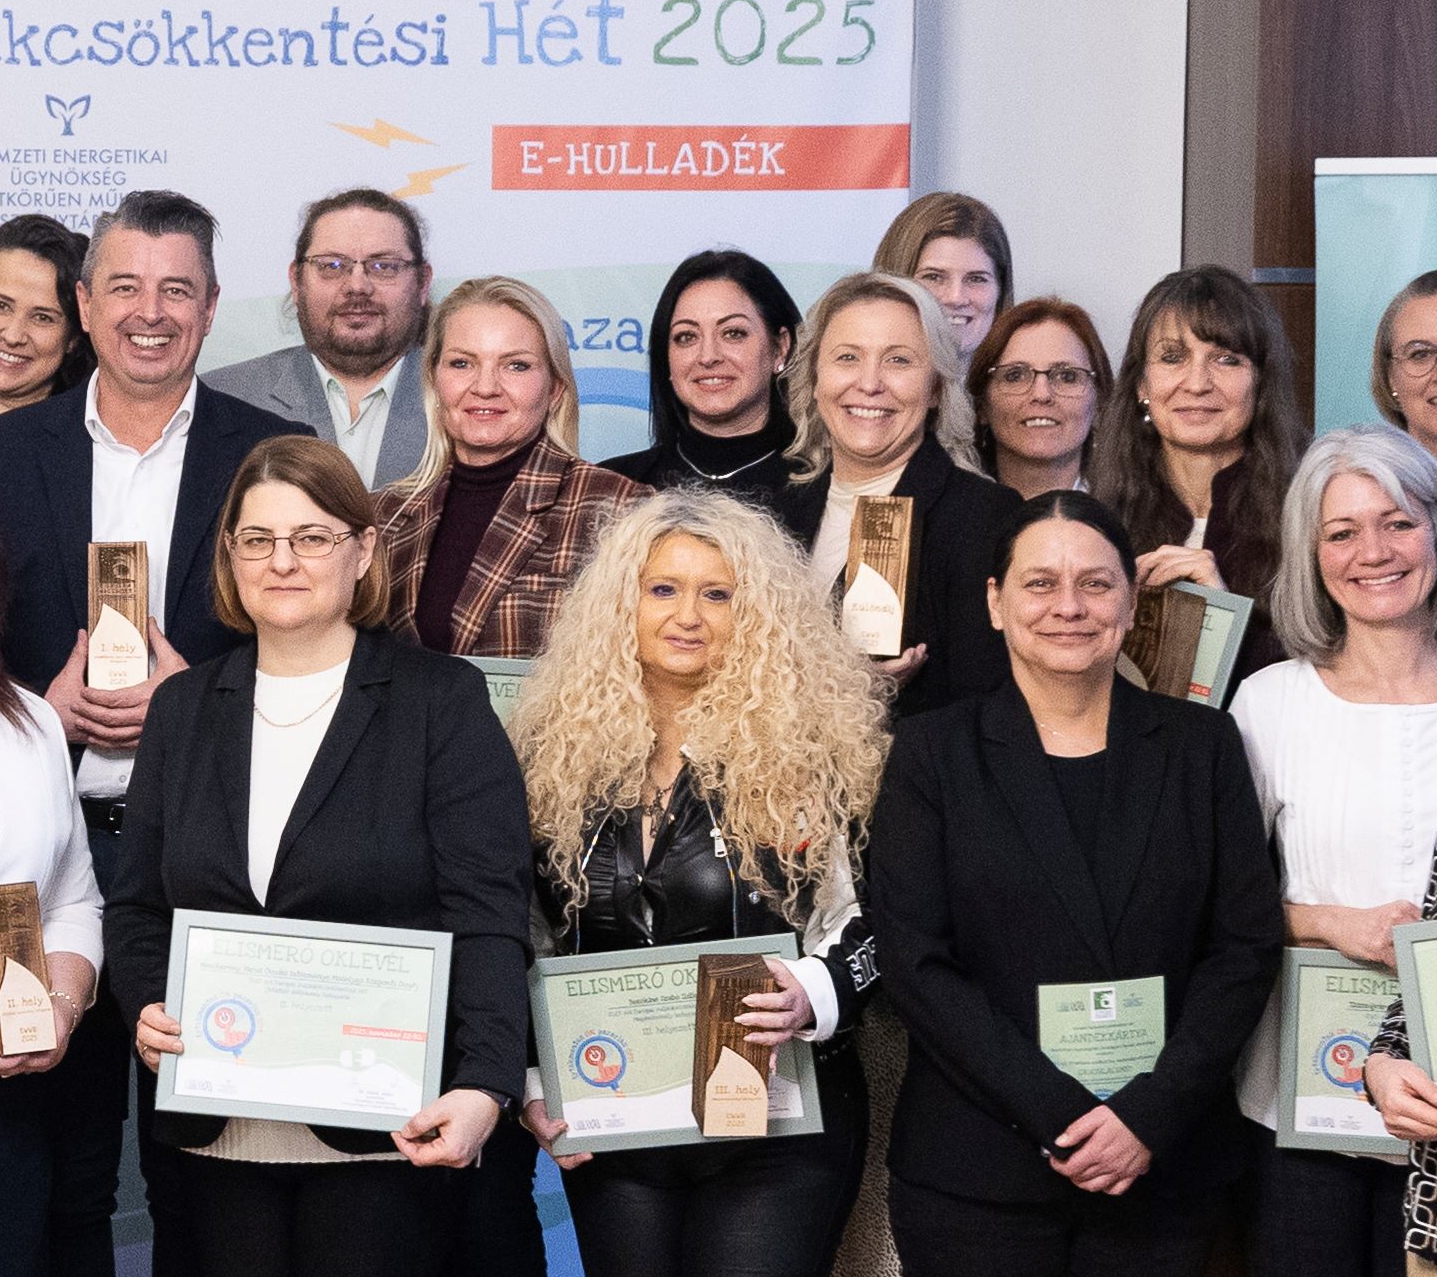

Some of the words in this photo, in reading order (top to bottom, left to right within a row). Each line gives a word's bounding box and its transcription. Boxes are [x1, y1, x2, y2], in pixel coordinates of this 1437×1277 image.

[53, 149, 167, 164] ENERGETIKAI
[520, 133, 787, 177] E-HULLADÉK
[10, 167, 126, 185] ÜGYNÖKSÉG
[1326, 975, 1401, 996] ELISME
